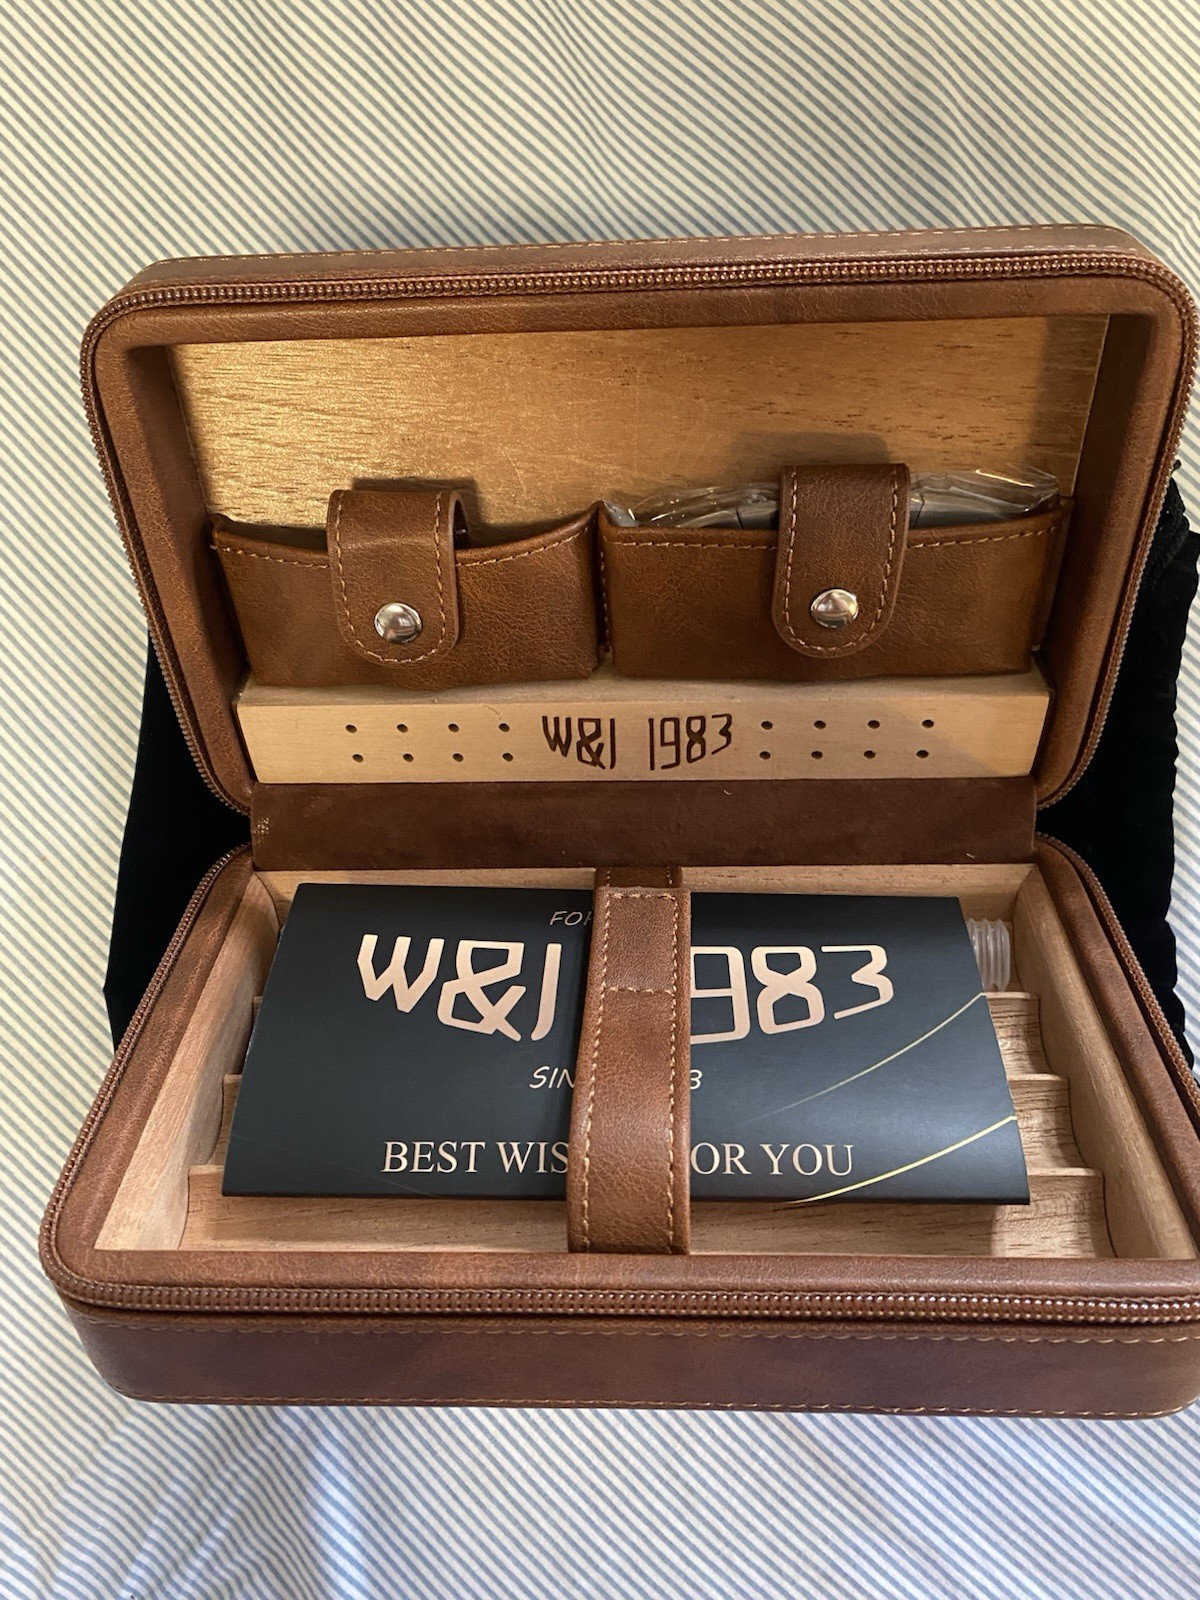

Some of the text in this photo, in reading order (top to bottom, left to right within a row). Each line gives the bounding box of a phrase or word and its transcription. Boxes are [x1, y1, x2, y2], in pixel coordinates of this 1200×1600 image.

[648, 713, 732, 771] 1983
[689, 944, 895, 1045] 983
[381, 1140, 486, 1174] BEST
[690, 1142, 752, 1176] OR
[759, 1142, 855, 1177] YOU
